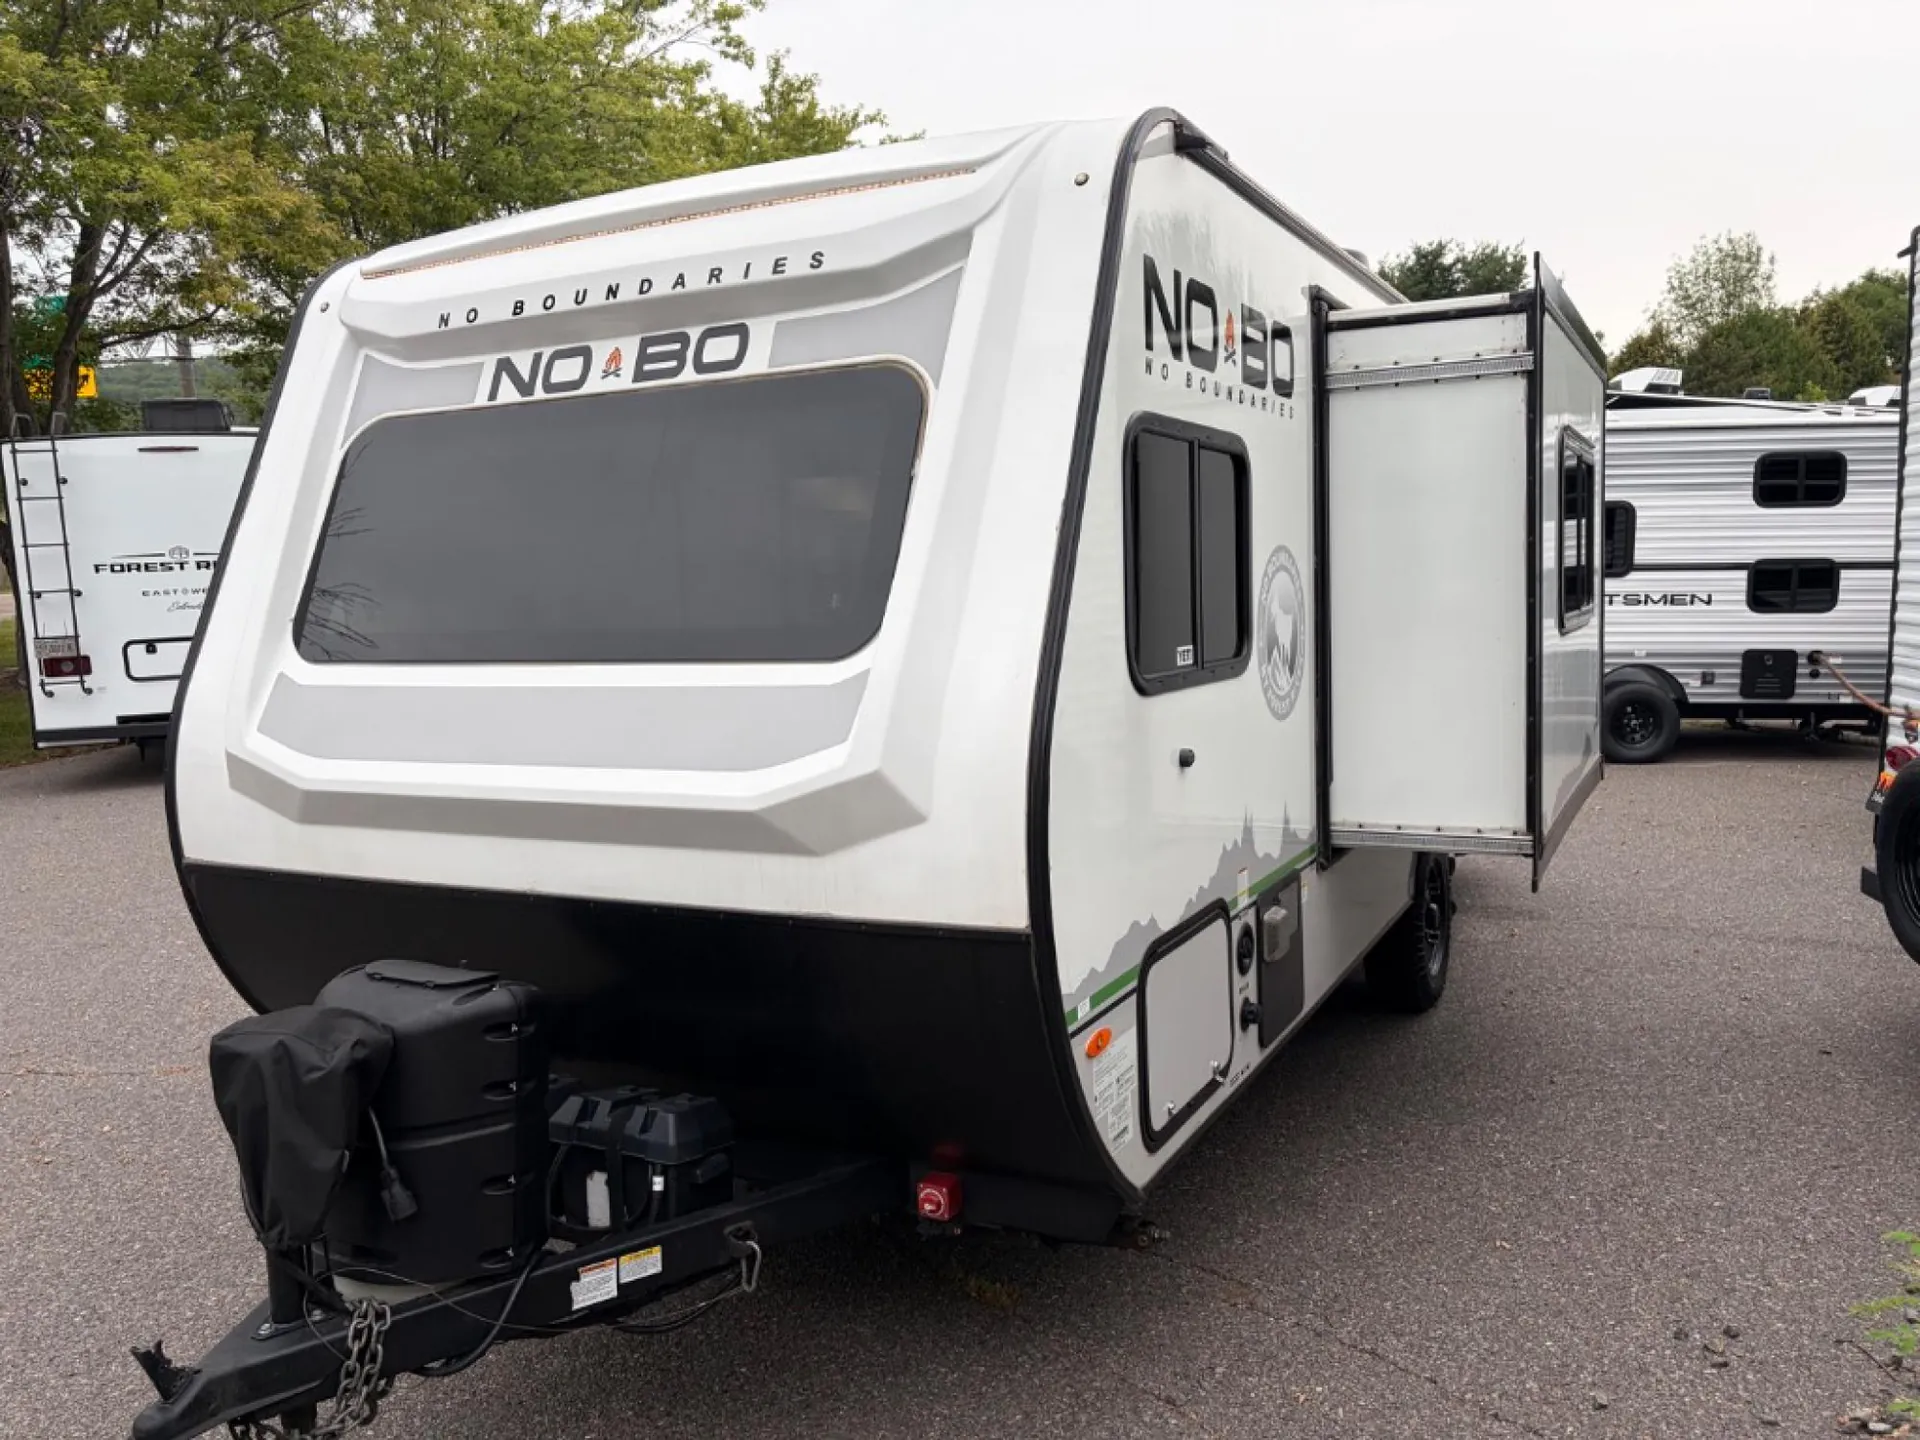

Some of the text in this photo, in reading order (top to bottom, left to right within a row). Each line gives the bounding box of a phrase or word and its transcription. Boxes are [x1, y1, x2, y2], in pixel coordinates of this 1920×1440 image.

[438, 250, 825, 329] NO BOUNDARIES
[1144, 355, 1295, 420] NO BOUNDARIES
[93, 561, 190, 575] FOREST
[141, 588, 179, 597] EAST
